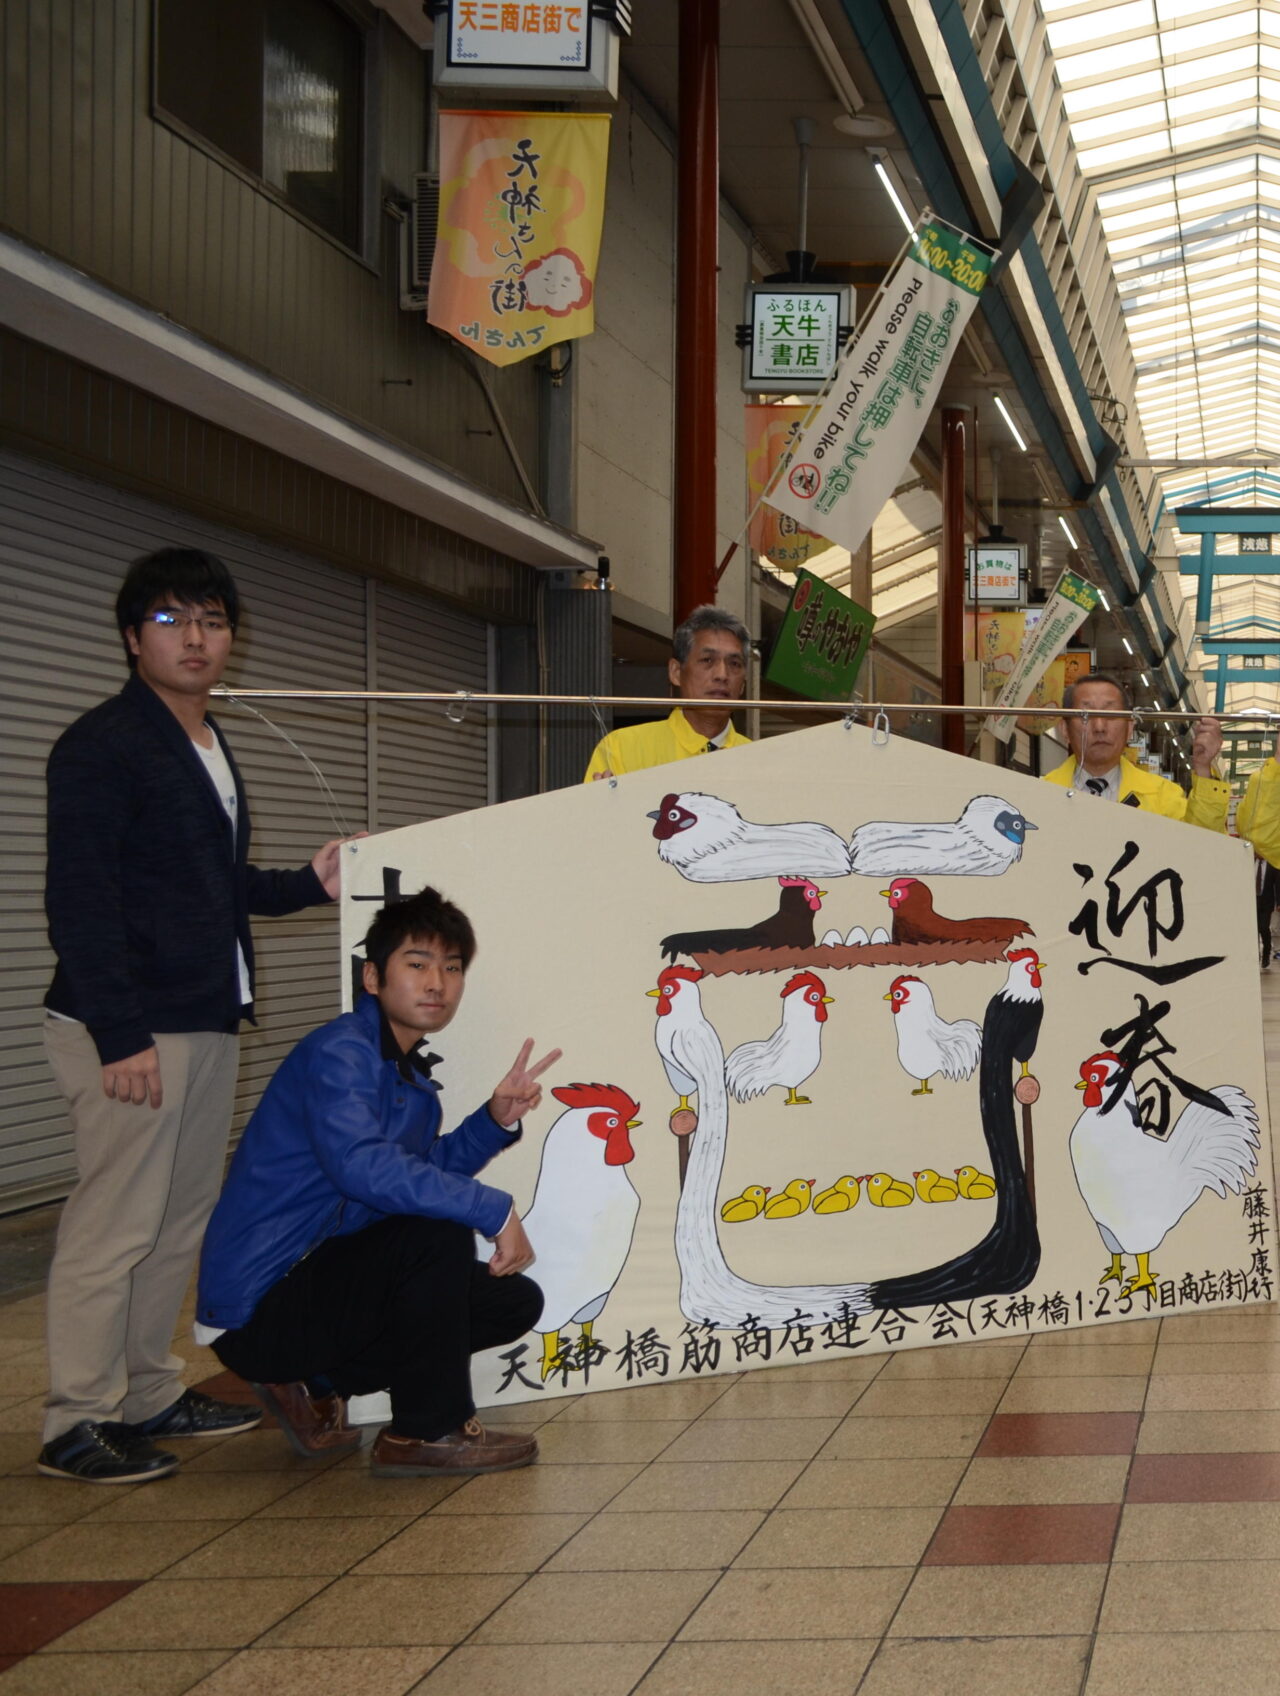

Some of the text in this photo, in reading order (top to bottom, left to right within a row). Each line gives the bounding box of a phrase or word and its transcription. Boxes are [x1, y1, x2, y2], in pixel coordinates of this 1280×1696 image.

[457, 1, 583, 33] 天三商店街で
[766, 298, 827, 312] ふるほん
[771, 314, 821, 337] 天牛
[770, 343, 820, 366] 書店
[813, 278, 923, 460] Please walk your bike
[1068, 840, 1237, 1137] 迎春
